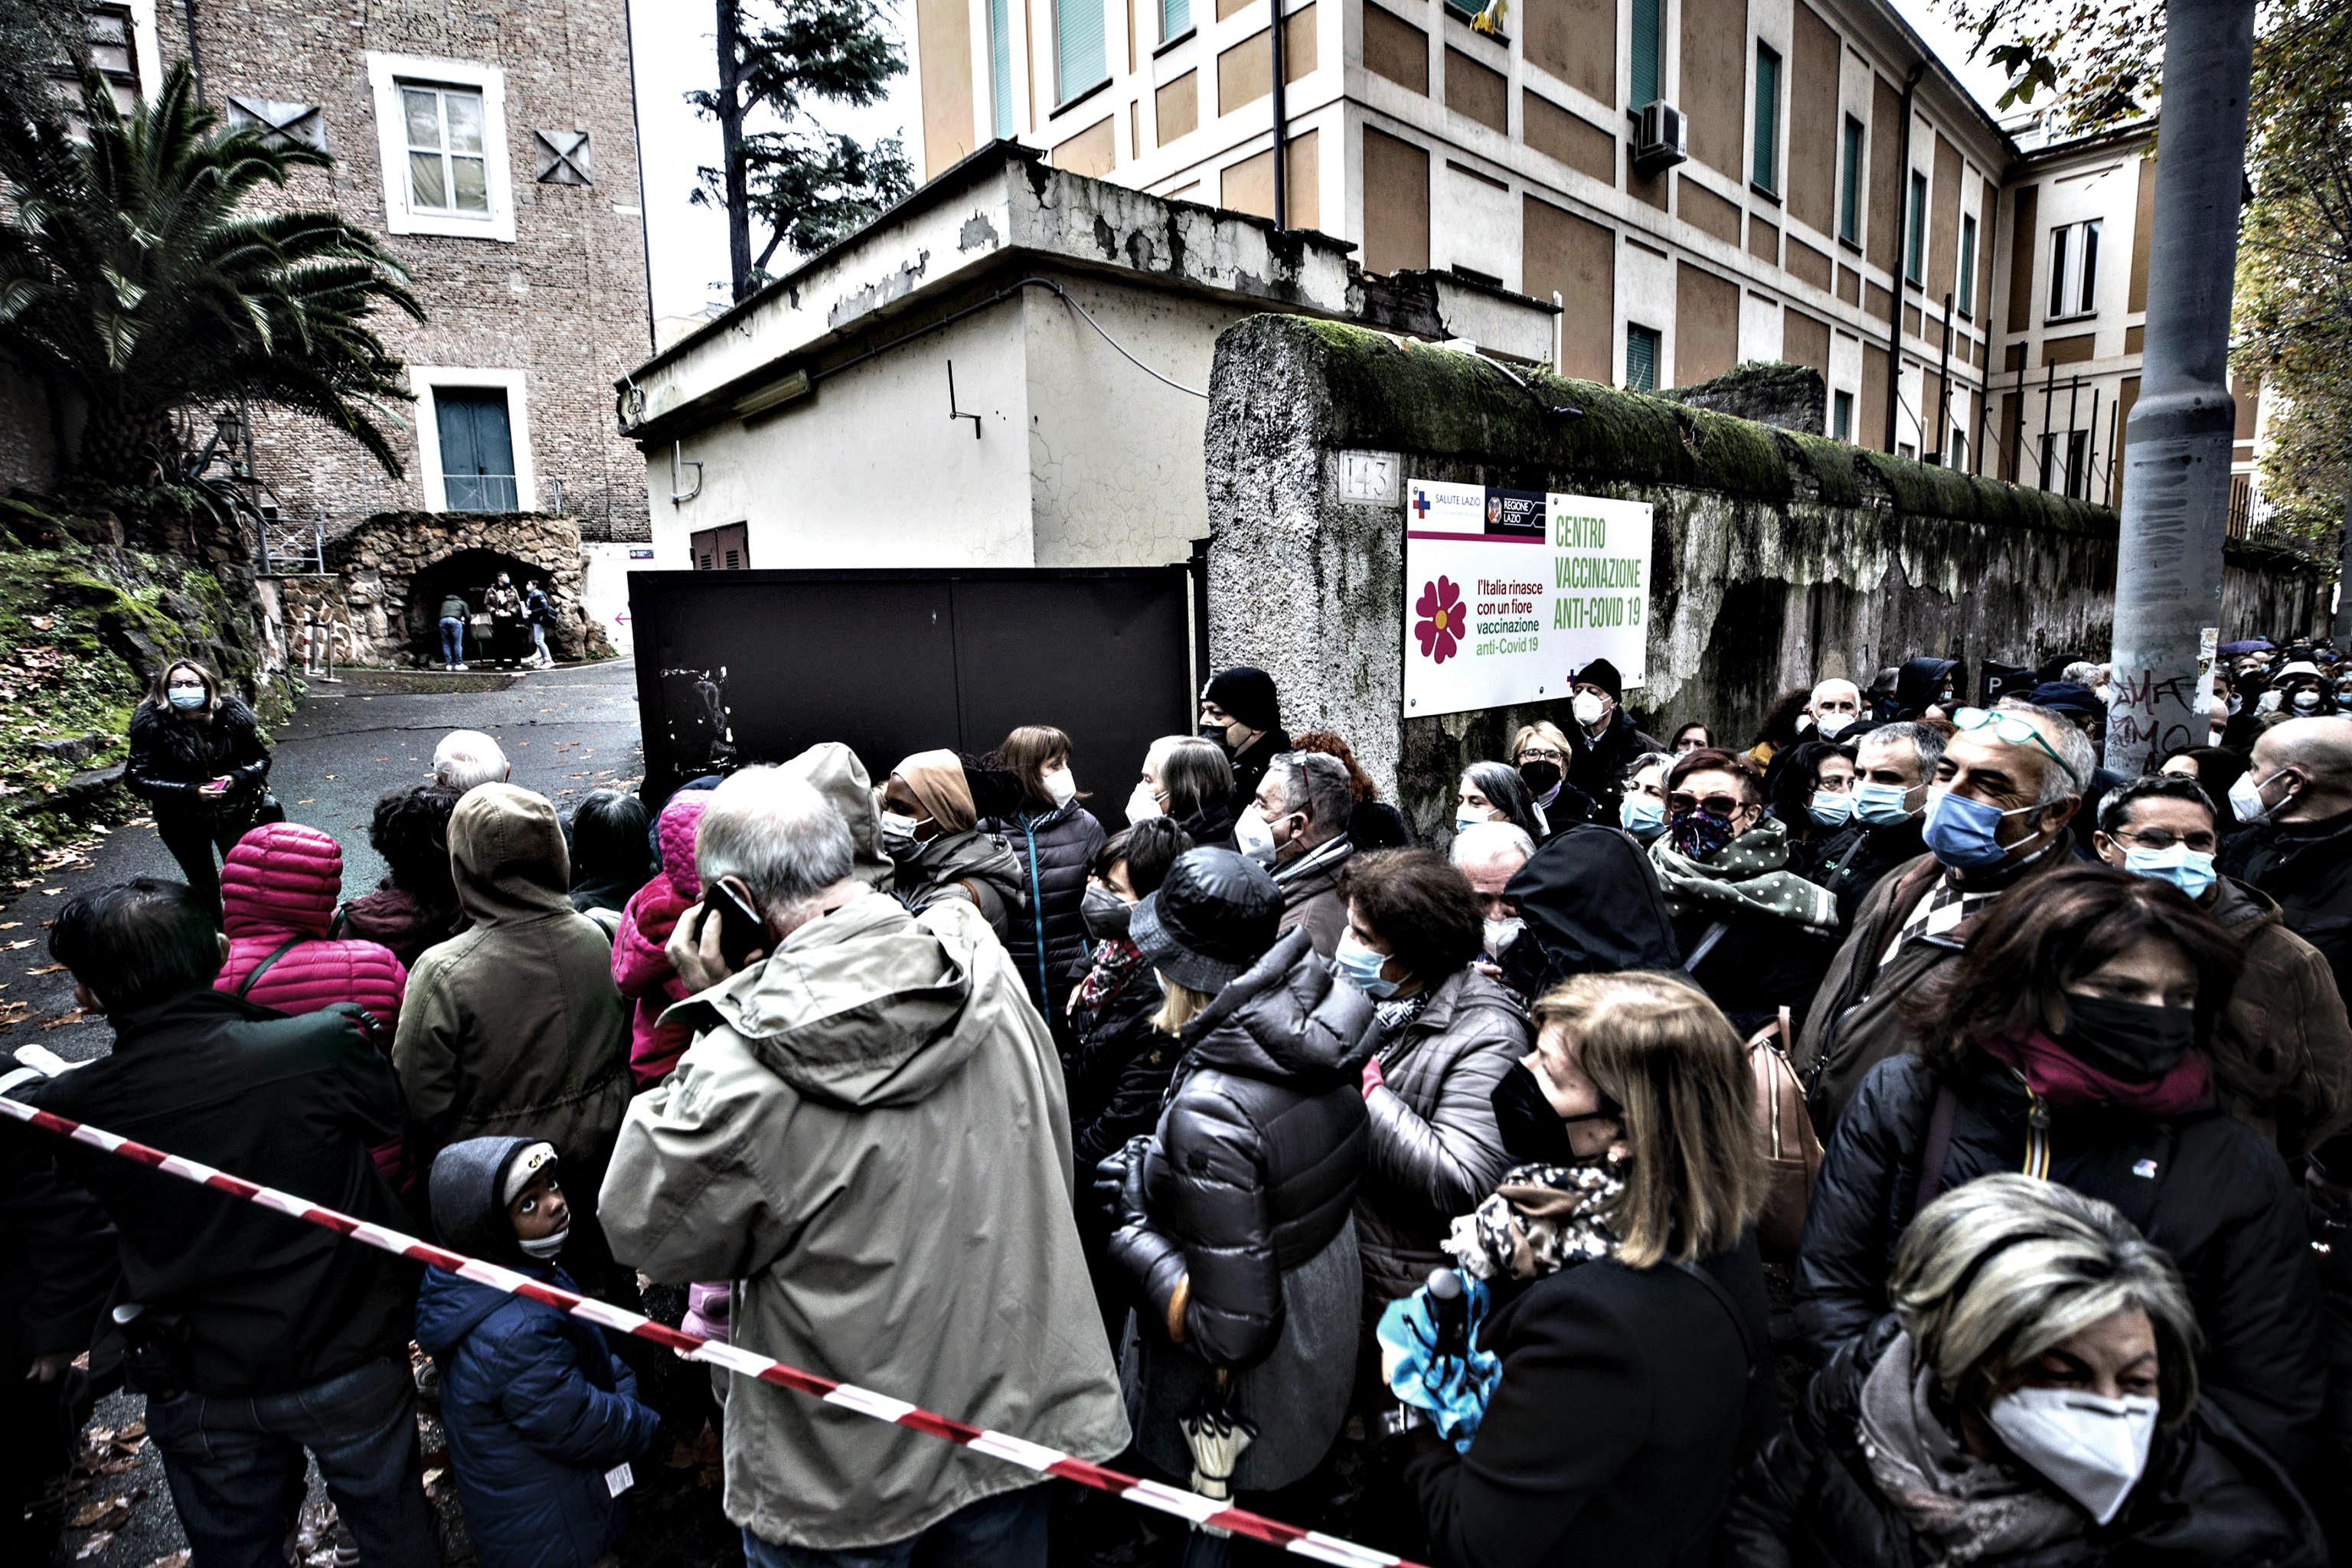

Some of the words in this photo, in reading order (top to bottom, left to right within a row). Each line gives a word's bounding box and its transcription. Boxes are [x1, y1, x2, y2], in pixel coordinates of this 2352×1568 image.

[1348, 458, 1387, 496] 143
[1436, 494, 1460, 505] SALUTE
[1462, 496, 1481, 507] LAZIO
[1504, 500, 1529, 511] REGIONE
[1504, 514, 1521, 524] LAZIO
[1556, 514, 1606, 549] CENTRO
[1555, 557, 1642, 589] VACCINAZIONE
[1478, 579, 1507, 595] l'Italia
[1508, 579, 1543, 595] rinasce
[1477, 603, 1495, 615] con
[1498, 602, 1510, 615] un
[1511, 598, 1533, 614] fiore
[1553, 596, 1624, 630] ANTI-COVID
[1628, 596, 1642, 626] 19
[1477, 617, 1540, 635] vaccinazione
[1476, 637, 1527, 655] anti-Covid
[1528, 636, 1538, 652] 19
[1988, 677, 2002, 694] P
